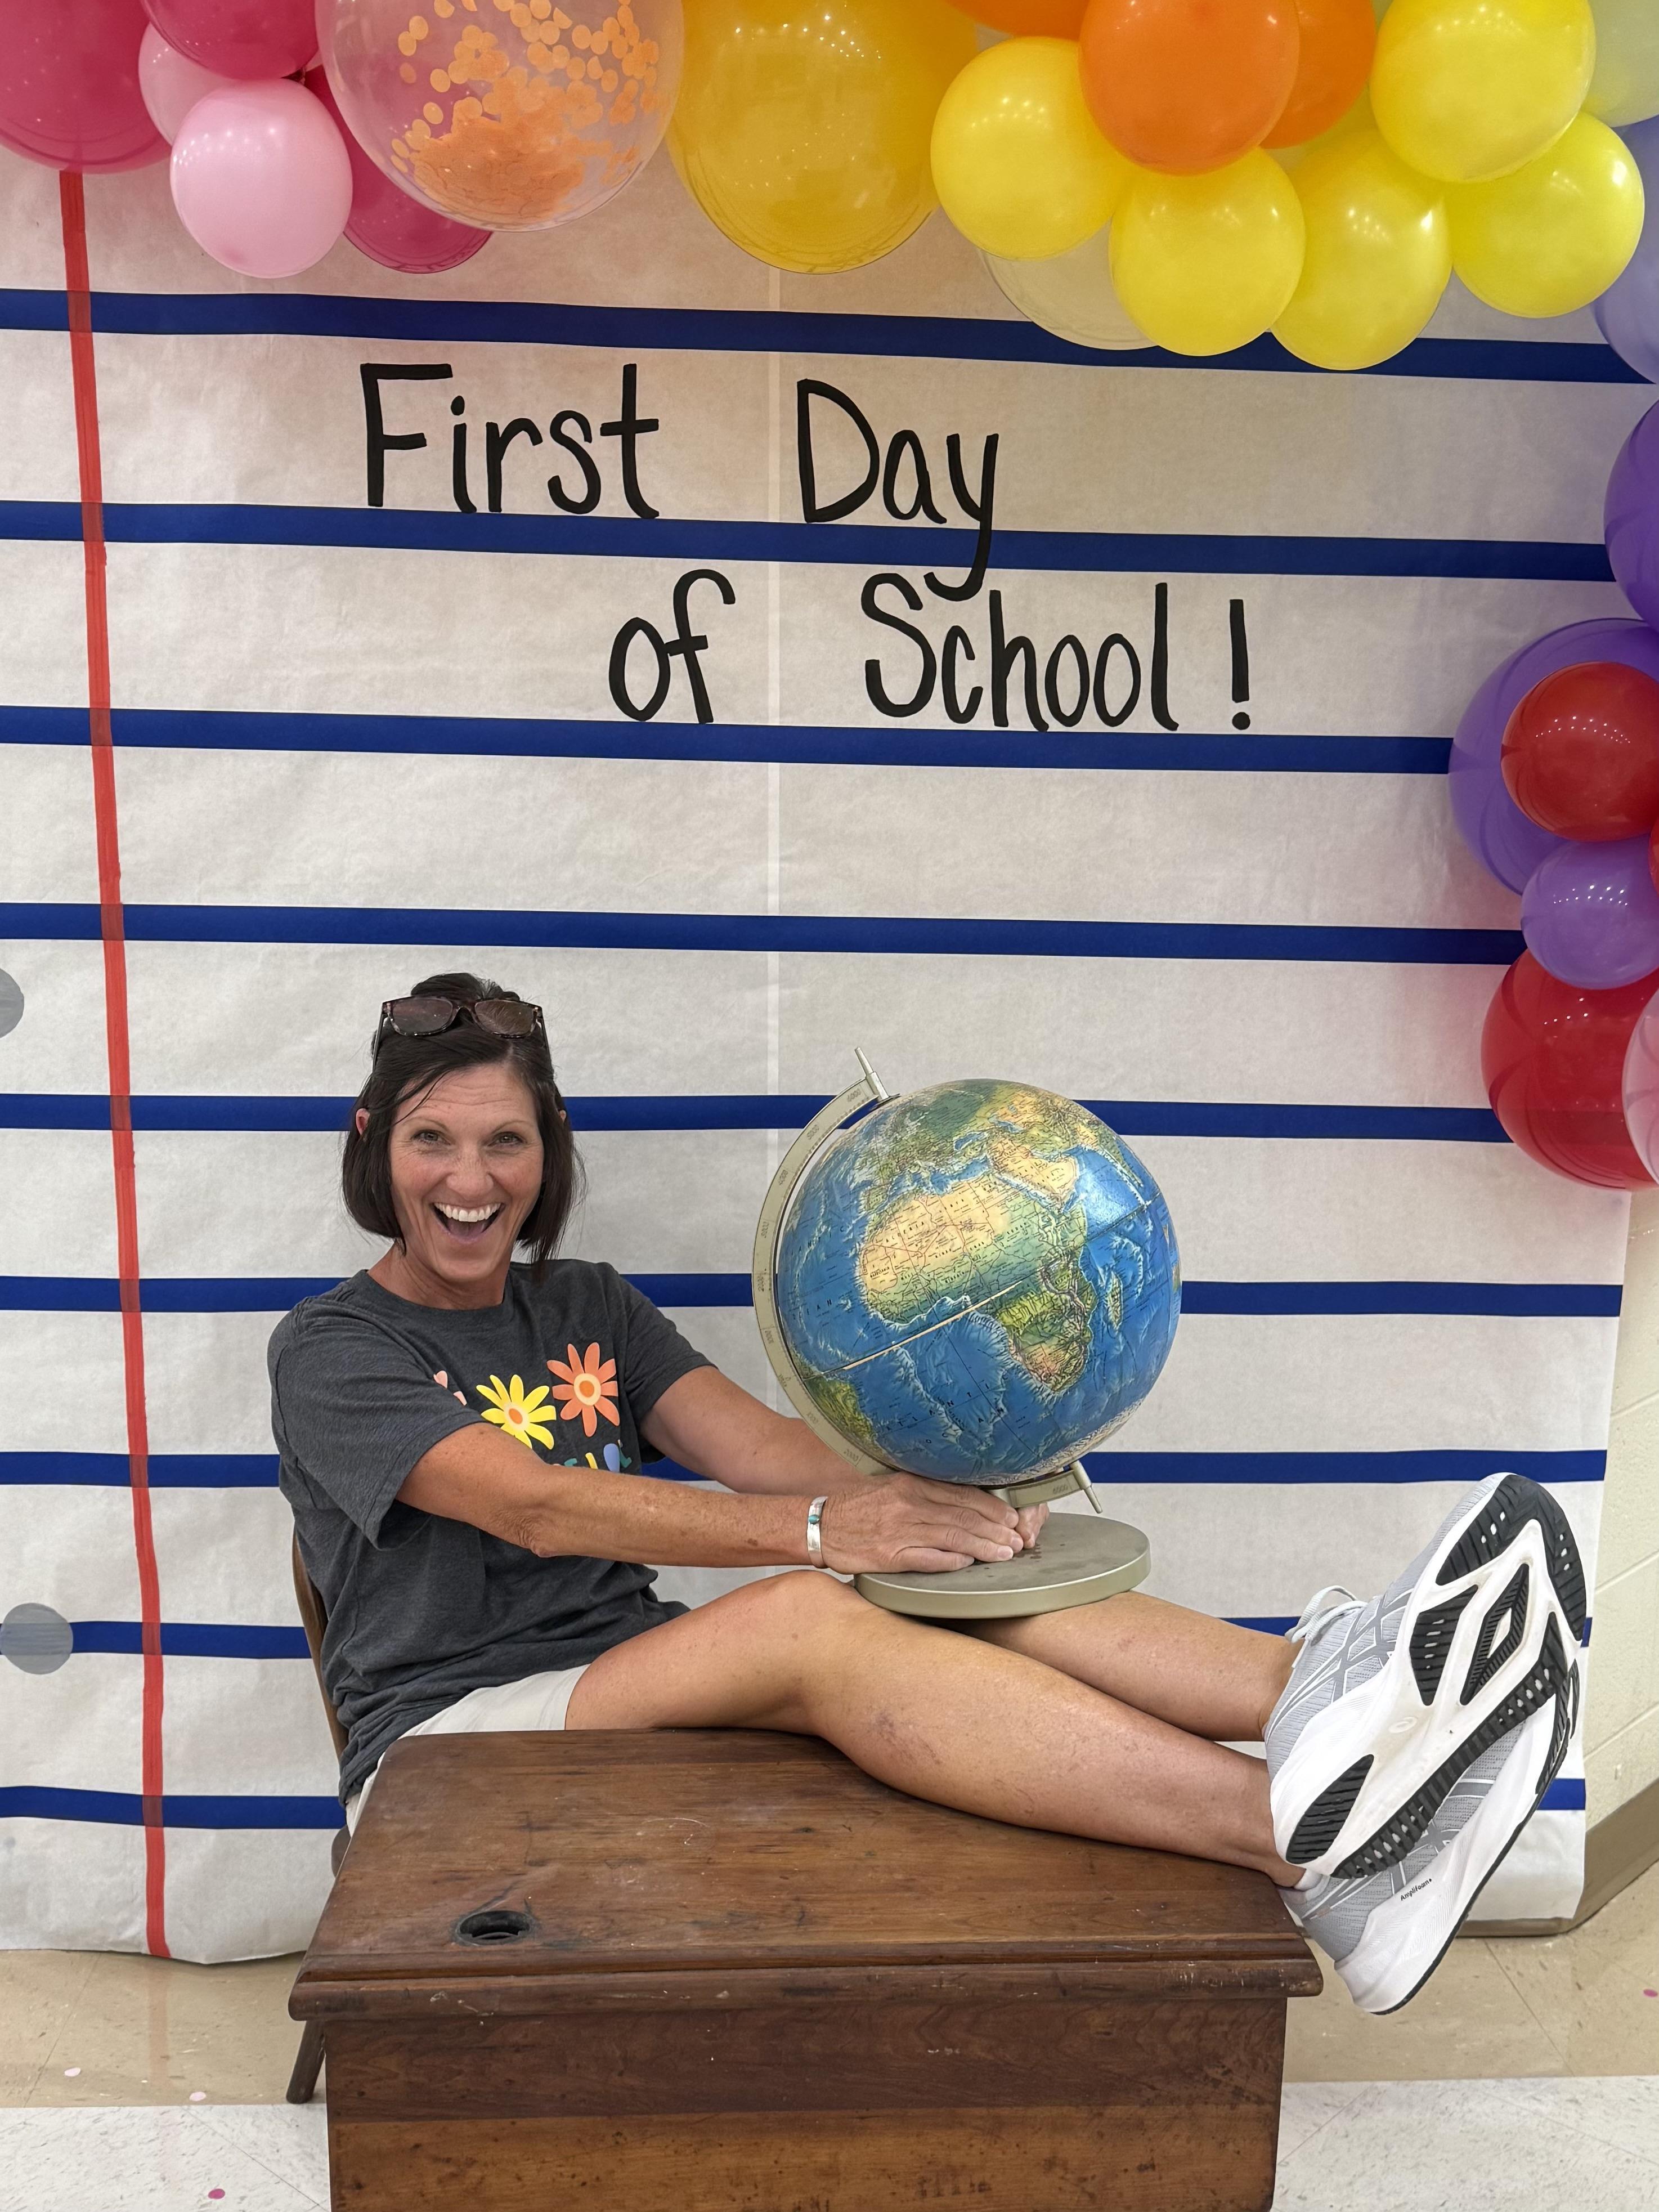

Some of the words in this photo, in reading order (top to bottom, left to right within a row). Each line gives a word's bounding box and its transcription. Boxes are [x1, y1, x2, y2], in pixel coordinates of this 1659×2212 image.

[360, 363, 660, 519] First
[797, 378, 999, 602] Day
[608, 569, 736, 725] of
[861, 573, 1179, 732] School
[1230, 599, 1250, 731] !
